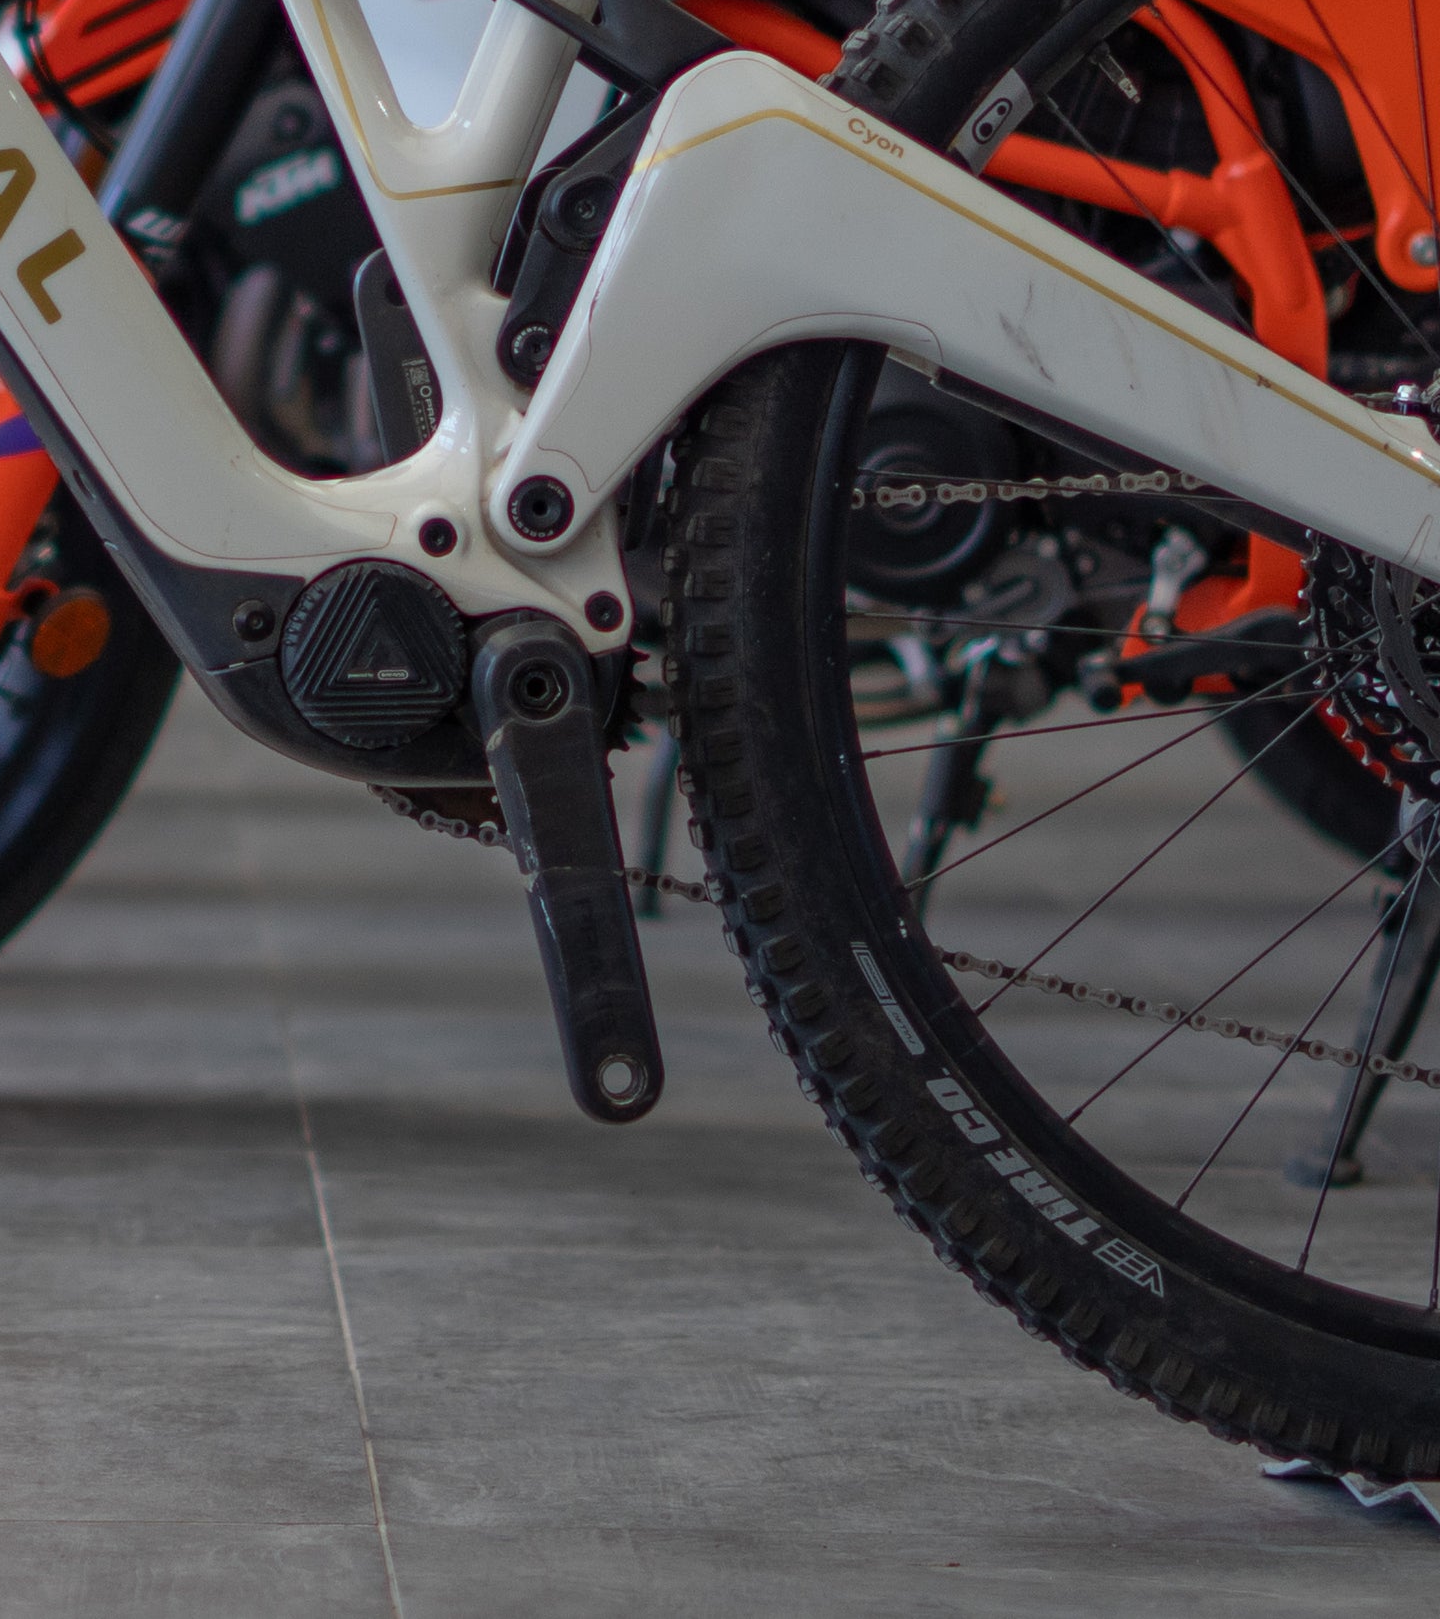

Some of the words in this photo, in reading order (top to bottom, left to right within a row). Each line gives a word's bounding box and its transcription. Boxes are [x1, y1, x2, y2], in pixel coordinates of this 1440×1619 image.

[847, 117, 905, 159] Cyon
[924, 1067, 1003, 1145] CO.
[983, 1146, 1101, 1246] TIRE
[1092, 1237, 1164, 1298] VEE
